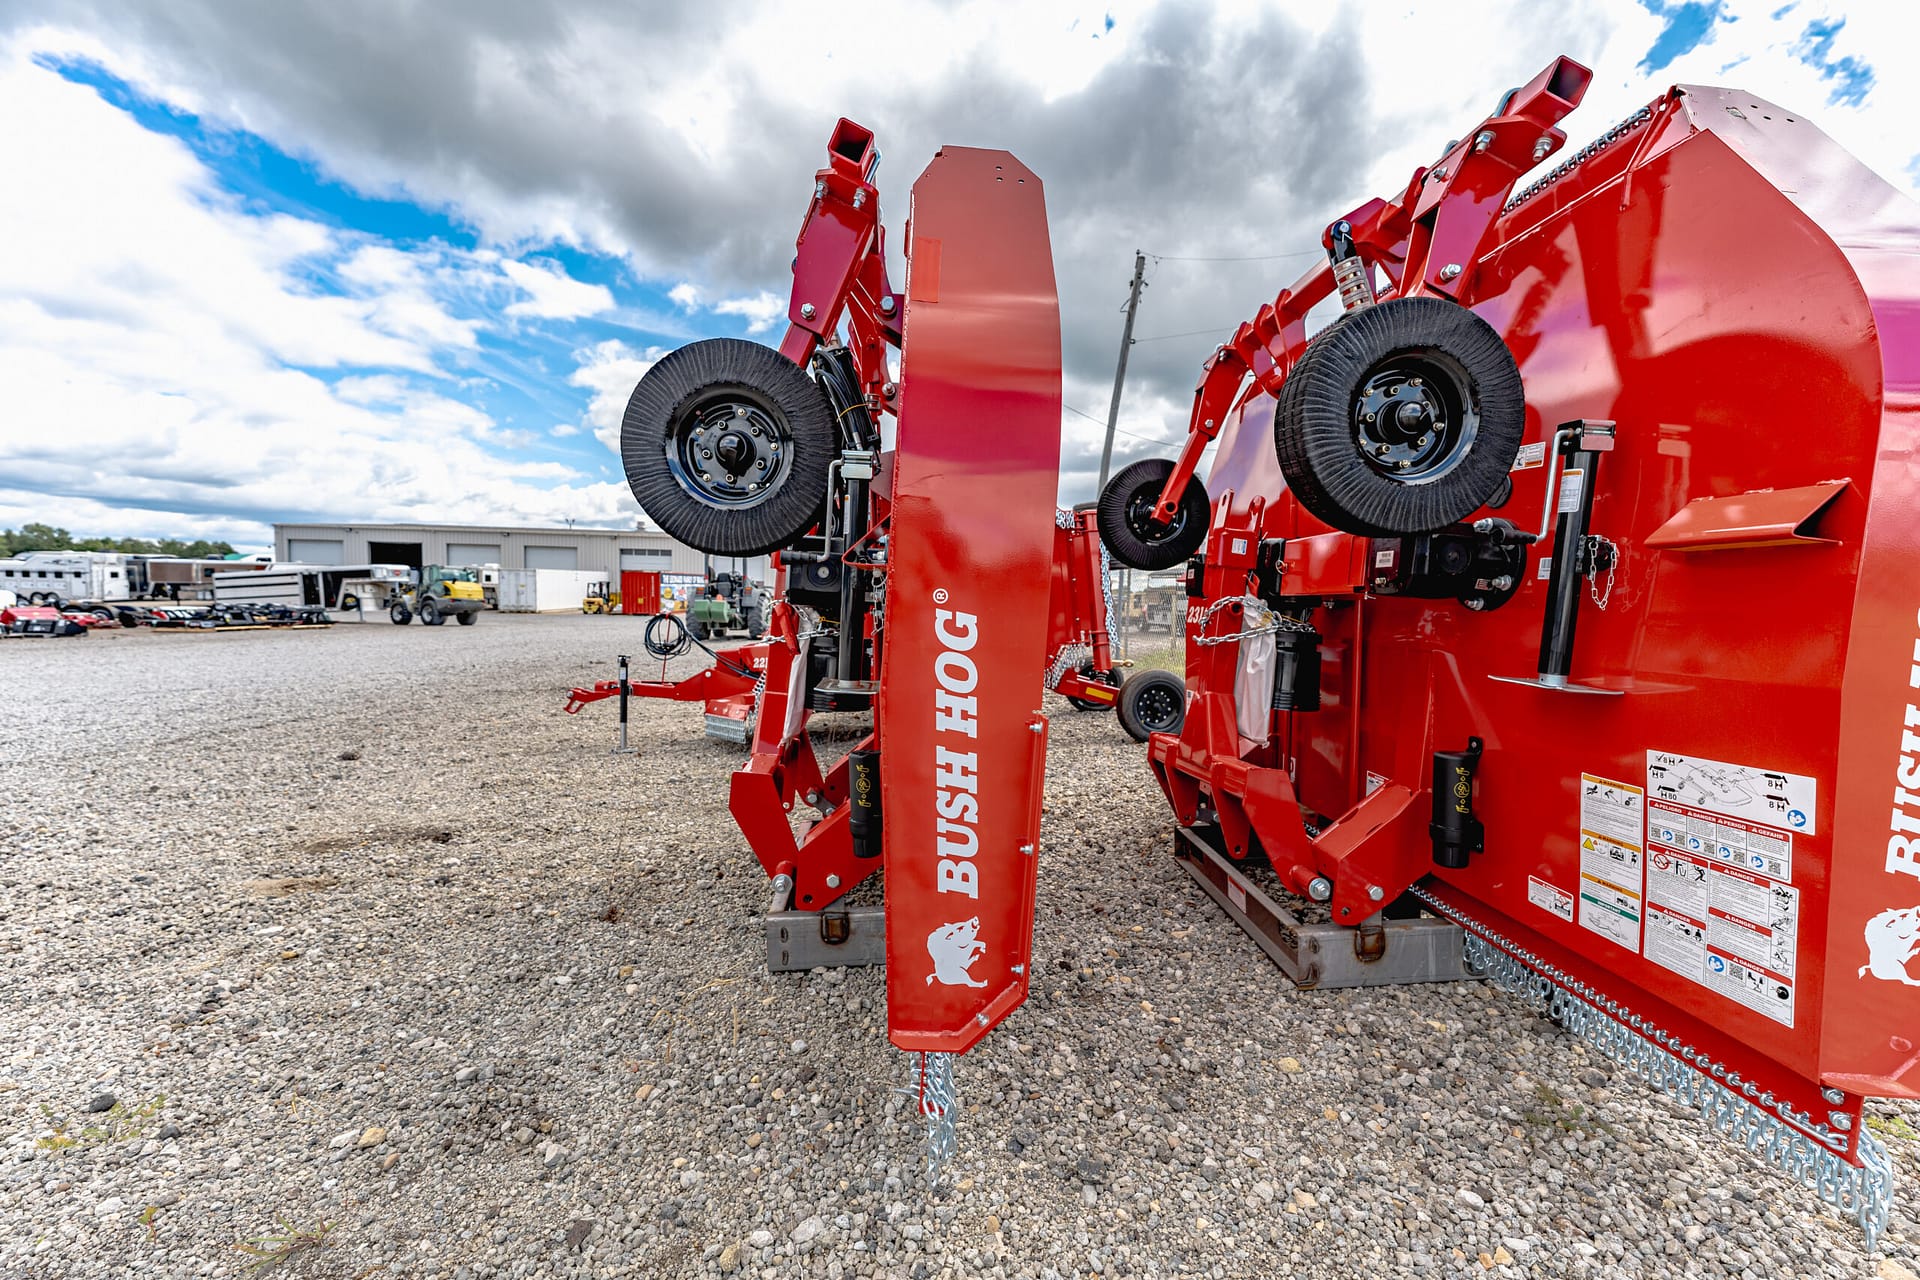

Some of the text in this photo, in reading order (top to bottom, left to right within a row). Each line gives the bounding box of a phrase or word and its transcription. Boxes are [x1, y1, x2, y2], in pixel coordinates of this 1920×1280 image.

[1660, 802, 1682, 814] PELIGRO
[936, 745, 979, 899] BUSH
[1693, 812, 1717, 822] DANGER
[1723, 819, 1746, 830] PERIGO
[1759, 829, 1785, 840] GEFAHR
[1668, 851, 1692, 862] DANGER
[1730, 870, 1755, 882] DANGER
[1669, 911, 1691, 923] DANGER
[1731, 916, 1756, 930] DANGER
[1739, 960, 1765, 974] DANGER
